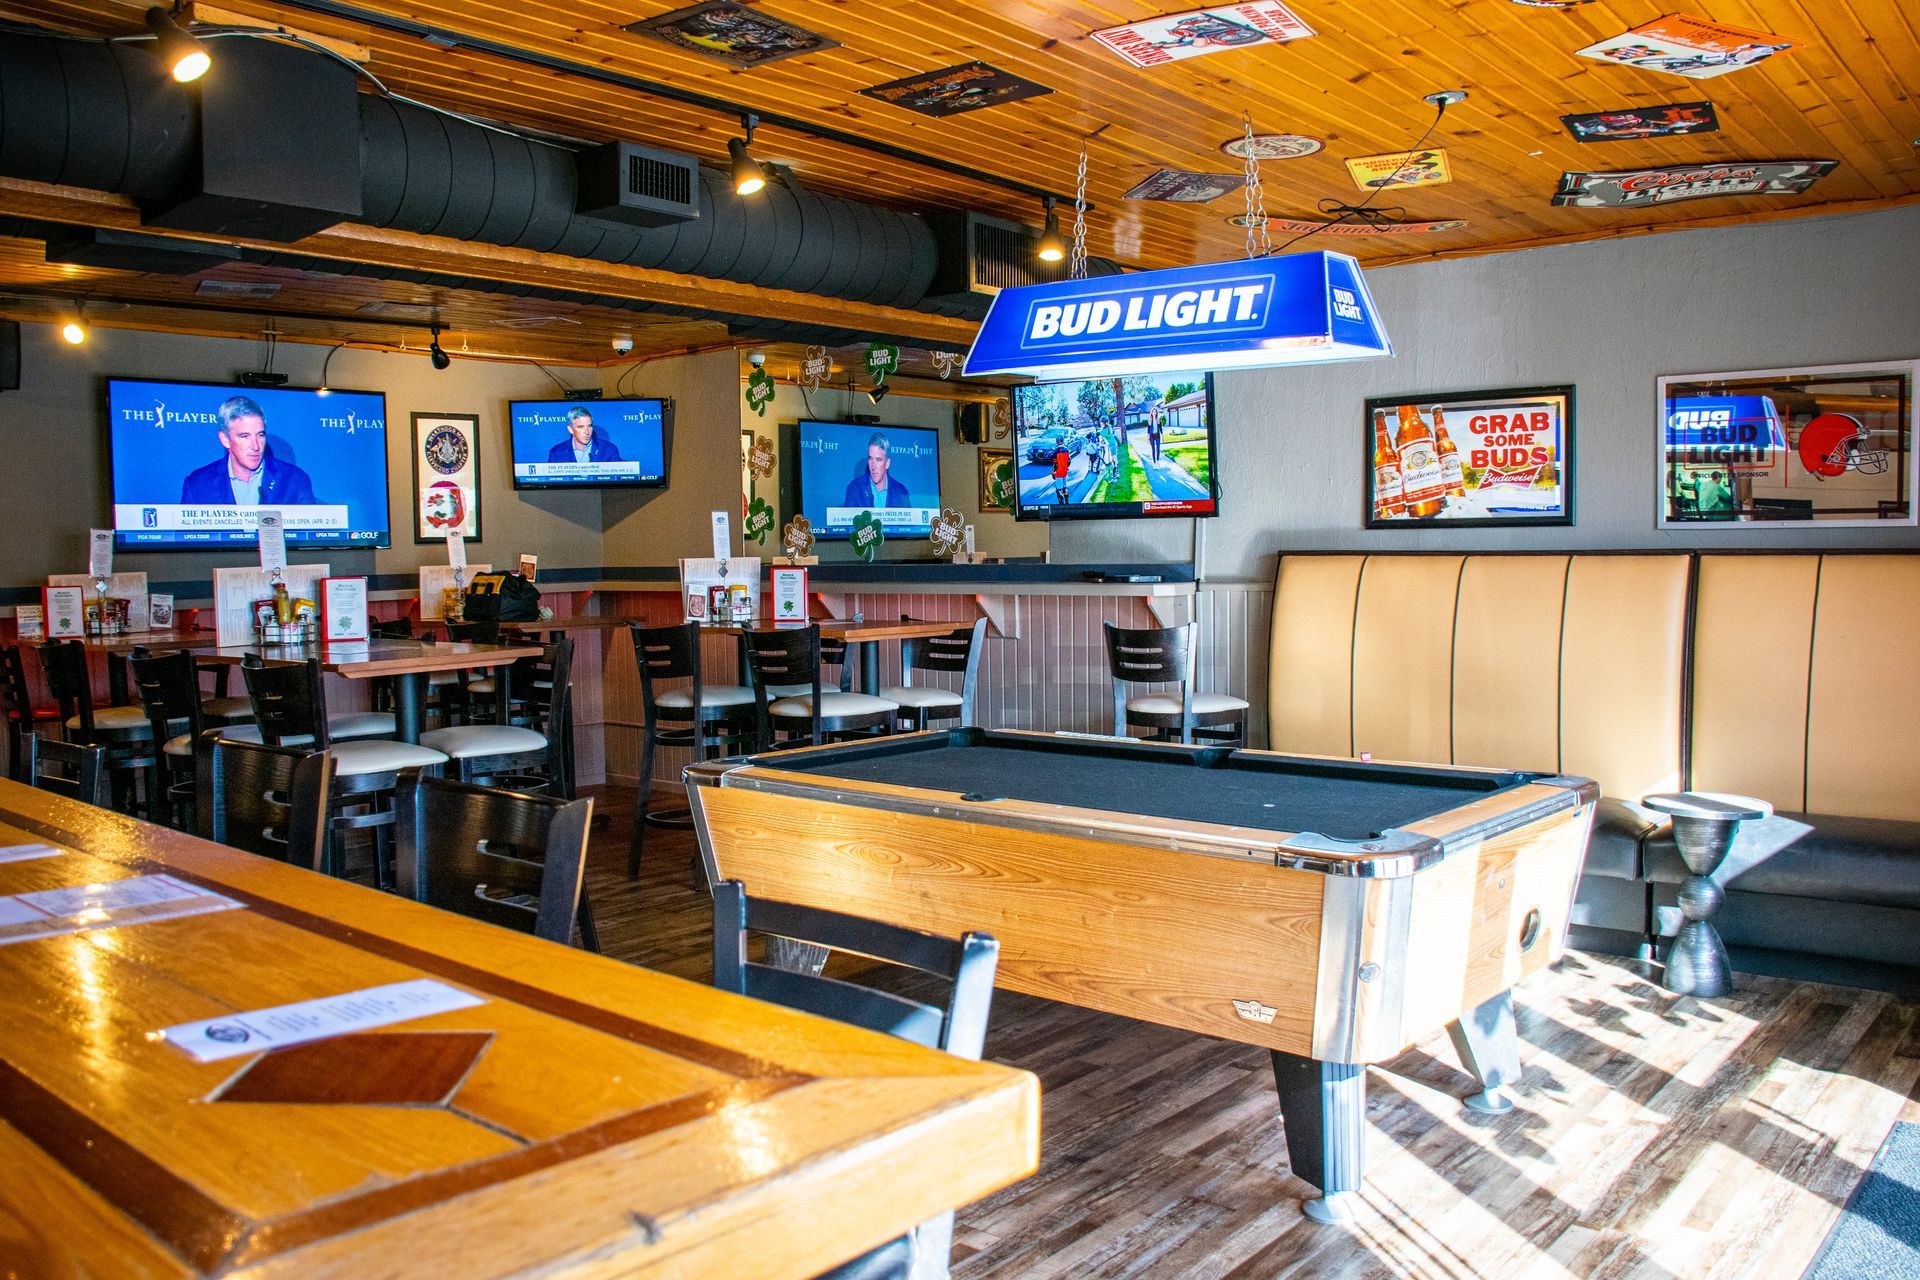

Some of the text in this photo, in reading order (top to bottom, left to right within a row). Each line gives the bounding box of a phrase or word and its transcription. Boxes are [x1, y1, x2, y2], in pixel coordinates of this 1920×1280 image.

[1234, 5, 1275, 28] PARKING
[1098, 28, 1176, 64] BIKERS ONLY
[1609, 167, 1758, 191] Coors
[1618, 177, 1753, 203] LIGHT
[1333, 288, 1355, 306] BUD
[1333, 301, 1362, 320] LIGHT
[1030, 300, 1122, 340] BUD
[872, 348, 889, 359] BUD
[808, 358, 822, 367] BUD
[870, 356, 892, 366] LIGHT
[806, 365, 826, 376] LIGHT
[752, 382, 766, 394] BUD
[752, 387, 770, 402] LIGHT
[122, 409, 218, 424] THE PLAYER
[320, 418, 384, 428] THE PLAY
[1469, 412, 1550, 434] GRAB
[1700, 424, 1758, 443] BUD
[1484, 434, 1534, 448] SOME
[754, 449, 768, 460] BUD
[1471, 446, 1548, 469] BUDS
[752, 456, 770, 469] LIGHT
[1476, 472, 1540, 484] Budweiser
[1000, 485, 1014, 498] LIG
[182, 510, 201, 518] THE
[202, 510, 238, 518] PLAYERS
[752, 511, 766, 524] BUD
[752, 516, 770, 532] LIGHT
[940, 522, 956, 536] BUD
[791, 527, 806, 540] BUD
[856, 530, 878, 546] LIGHT
[858, 525, 874, 538] BUD
[935, 527, 958, 544] LIGHT
[788, 534, 808, 548] LIGHT
